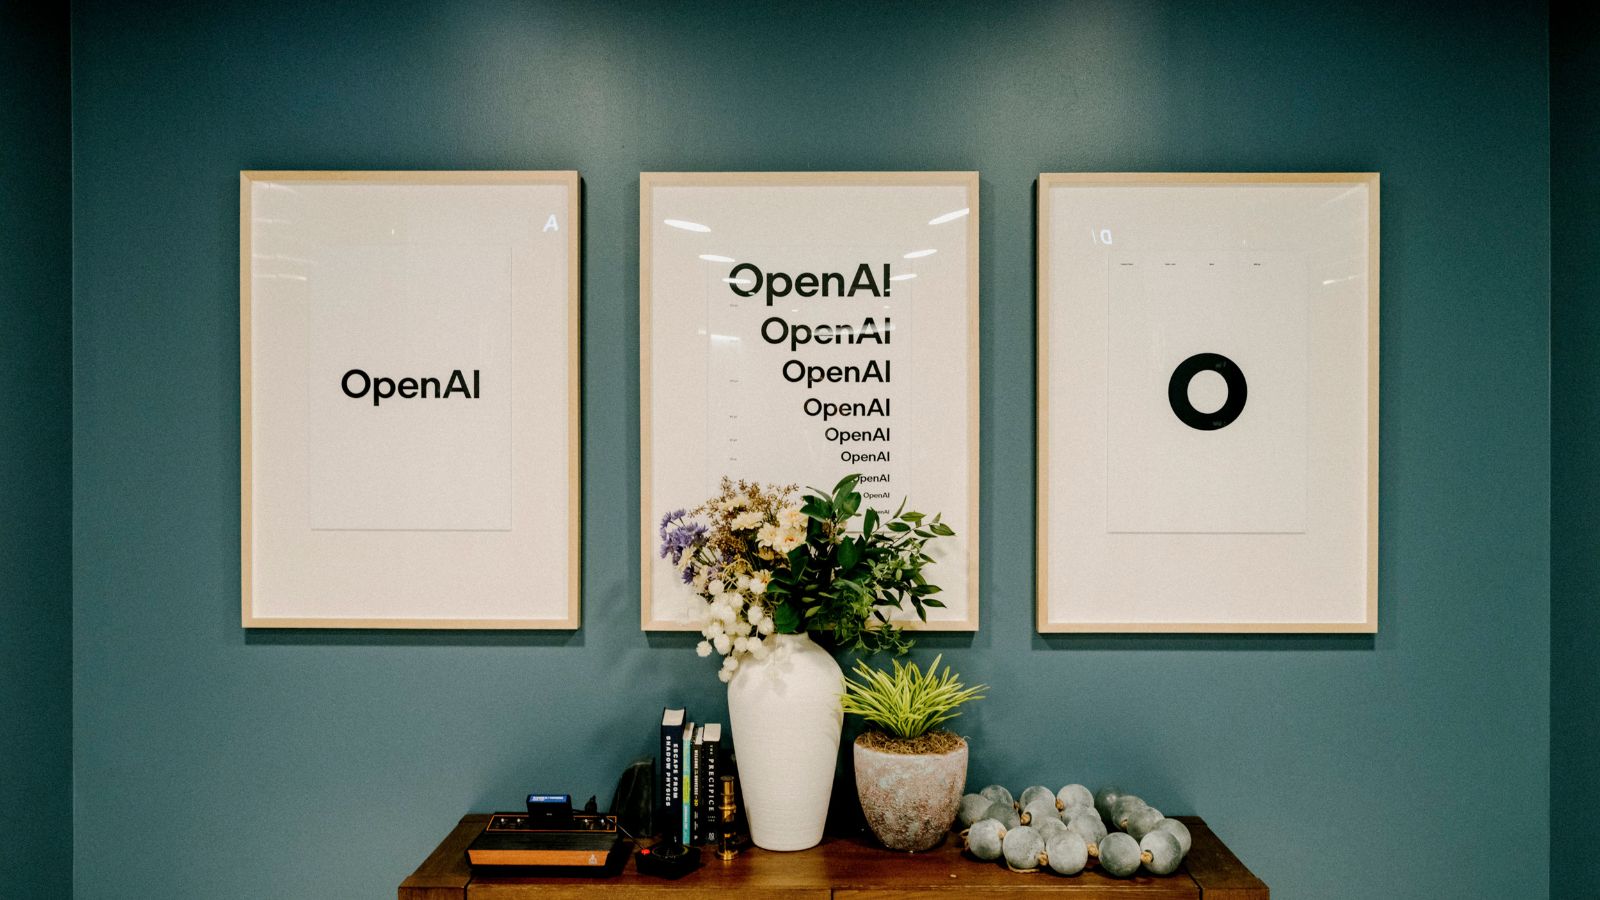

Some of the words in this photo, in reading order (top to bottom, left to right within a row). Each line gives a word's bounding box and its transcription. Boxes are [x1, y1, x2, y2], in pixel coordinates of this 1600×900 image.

[729, 263, 890, 306] OpenAI
[761, 317, 890, 351] OpenAI
[341, 369, 479, 406] OpenAI
[783, 360, 890, 388] OpenAI
[1168, 353, 1247, 431] O
[804, 398, 890, 421] OpenAI
[825, 427, 890, 445] OpenAI
[841, 451, 889, 464] OpenAI
